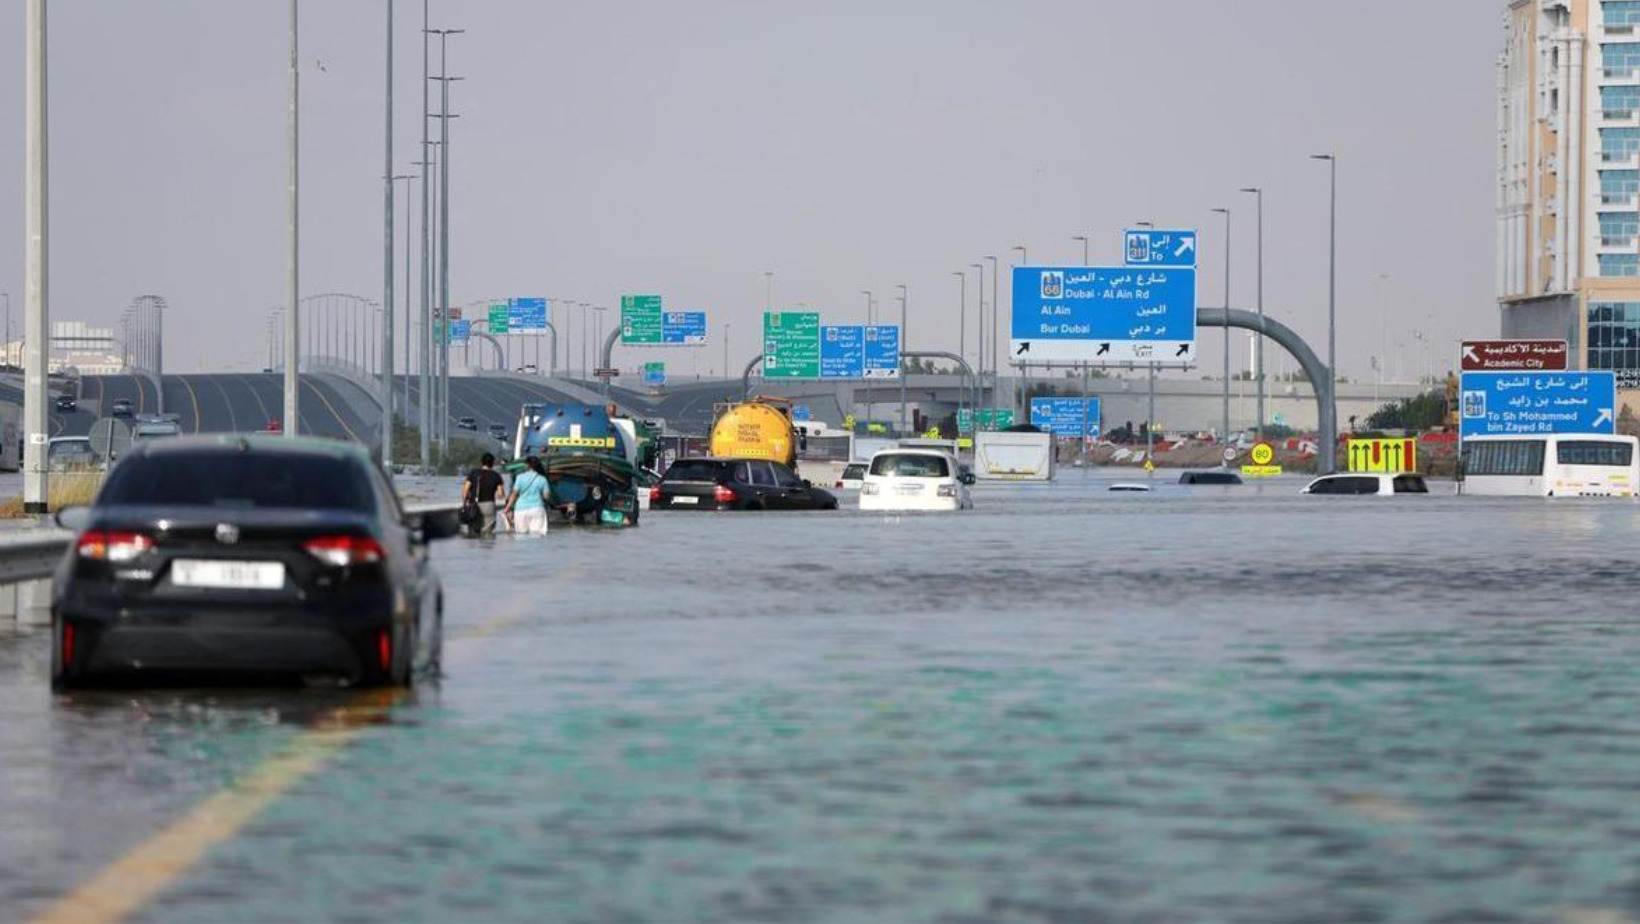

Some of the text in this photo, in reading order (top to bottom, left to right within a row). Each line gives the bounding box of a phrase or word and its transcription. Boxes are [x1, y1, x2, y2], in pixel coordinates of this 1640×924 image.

[1151, 235, 1170, 250] إلى
[1151, 252, 1164, 261] To
[1065, 272, 1095, 284] العين
[1110, 274, 1131, 288] دبي
[1136, 272, 1167, 286] شارع
[1044, 285, 1060, 295] 66
[1065, 289, 1094, 298] Dubai
[1103, 289, 1114, 298] Al
[1116, 289, 1132, 298] Ain
[1136, 289, 1150, 298] Rd
[1041, 306, 1071, 315] Al Ain
[1136, 304, 1166, 317] العين
[1040, 324, 1090, 333] Bur Dubai
[1129, 325, 1166, 338] بر دبي
[1533, 344, 1566, 355] المدينة
[1483, 358, 1544, 369] Academic City
[1496, 376, 1588, 392] إلى شارع الشيخ
[1535, 396, 1549, 407] بن
[1553, 396, 1588, 405] محمد
[1487, 411, 1578, 421] To Sh Mohammed
[1487, 422, 1552, 433] bin Zayed Rd
